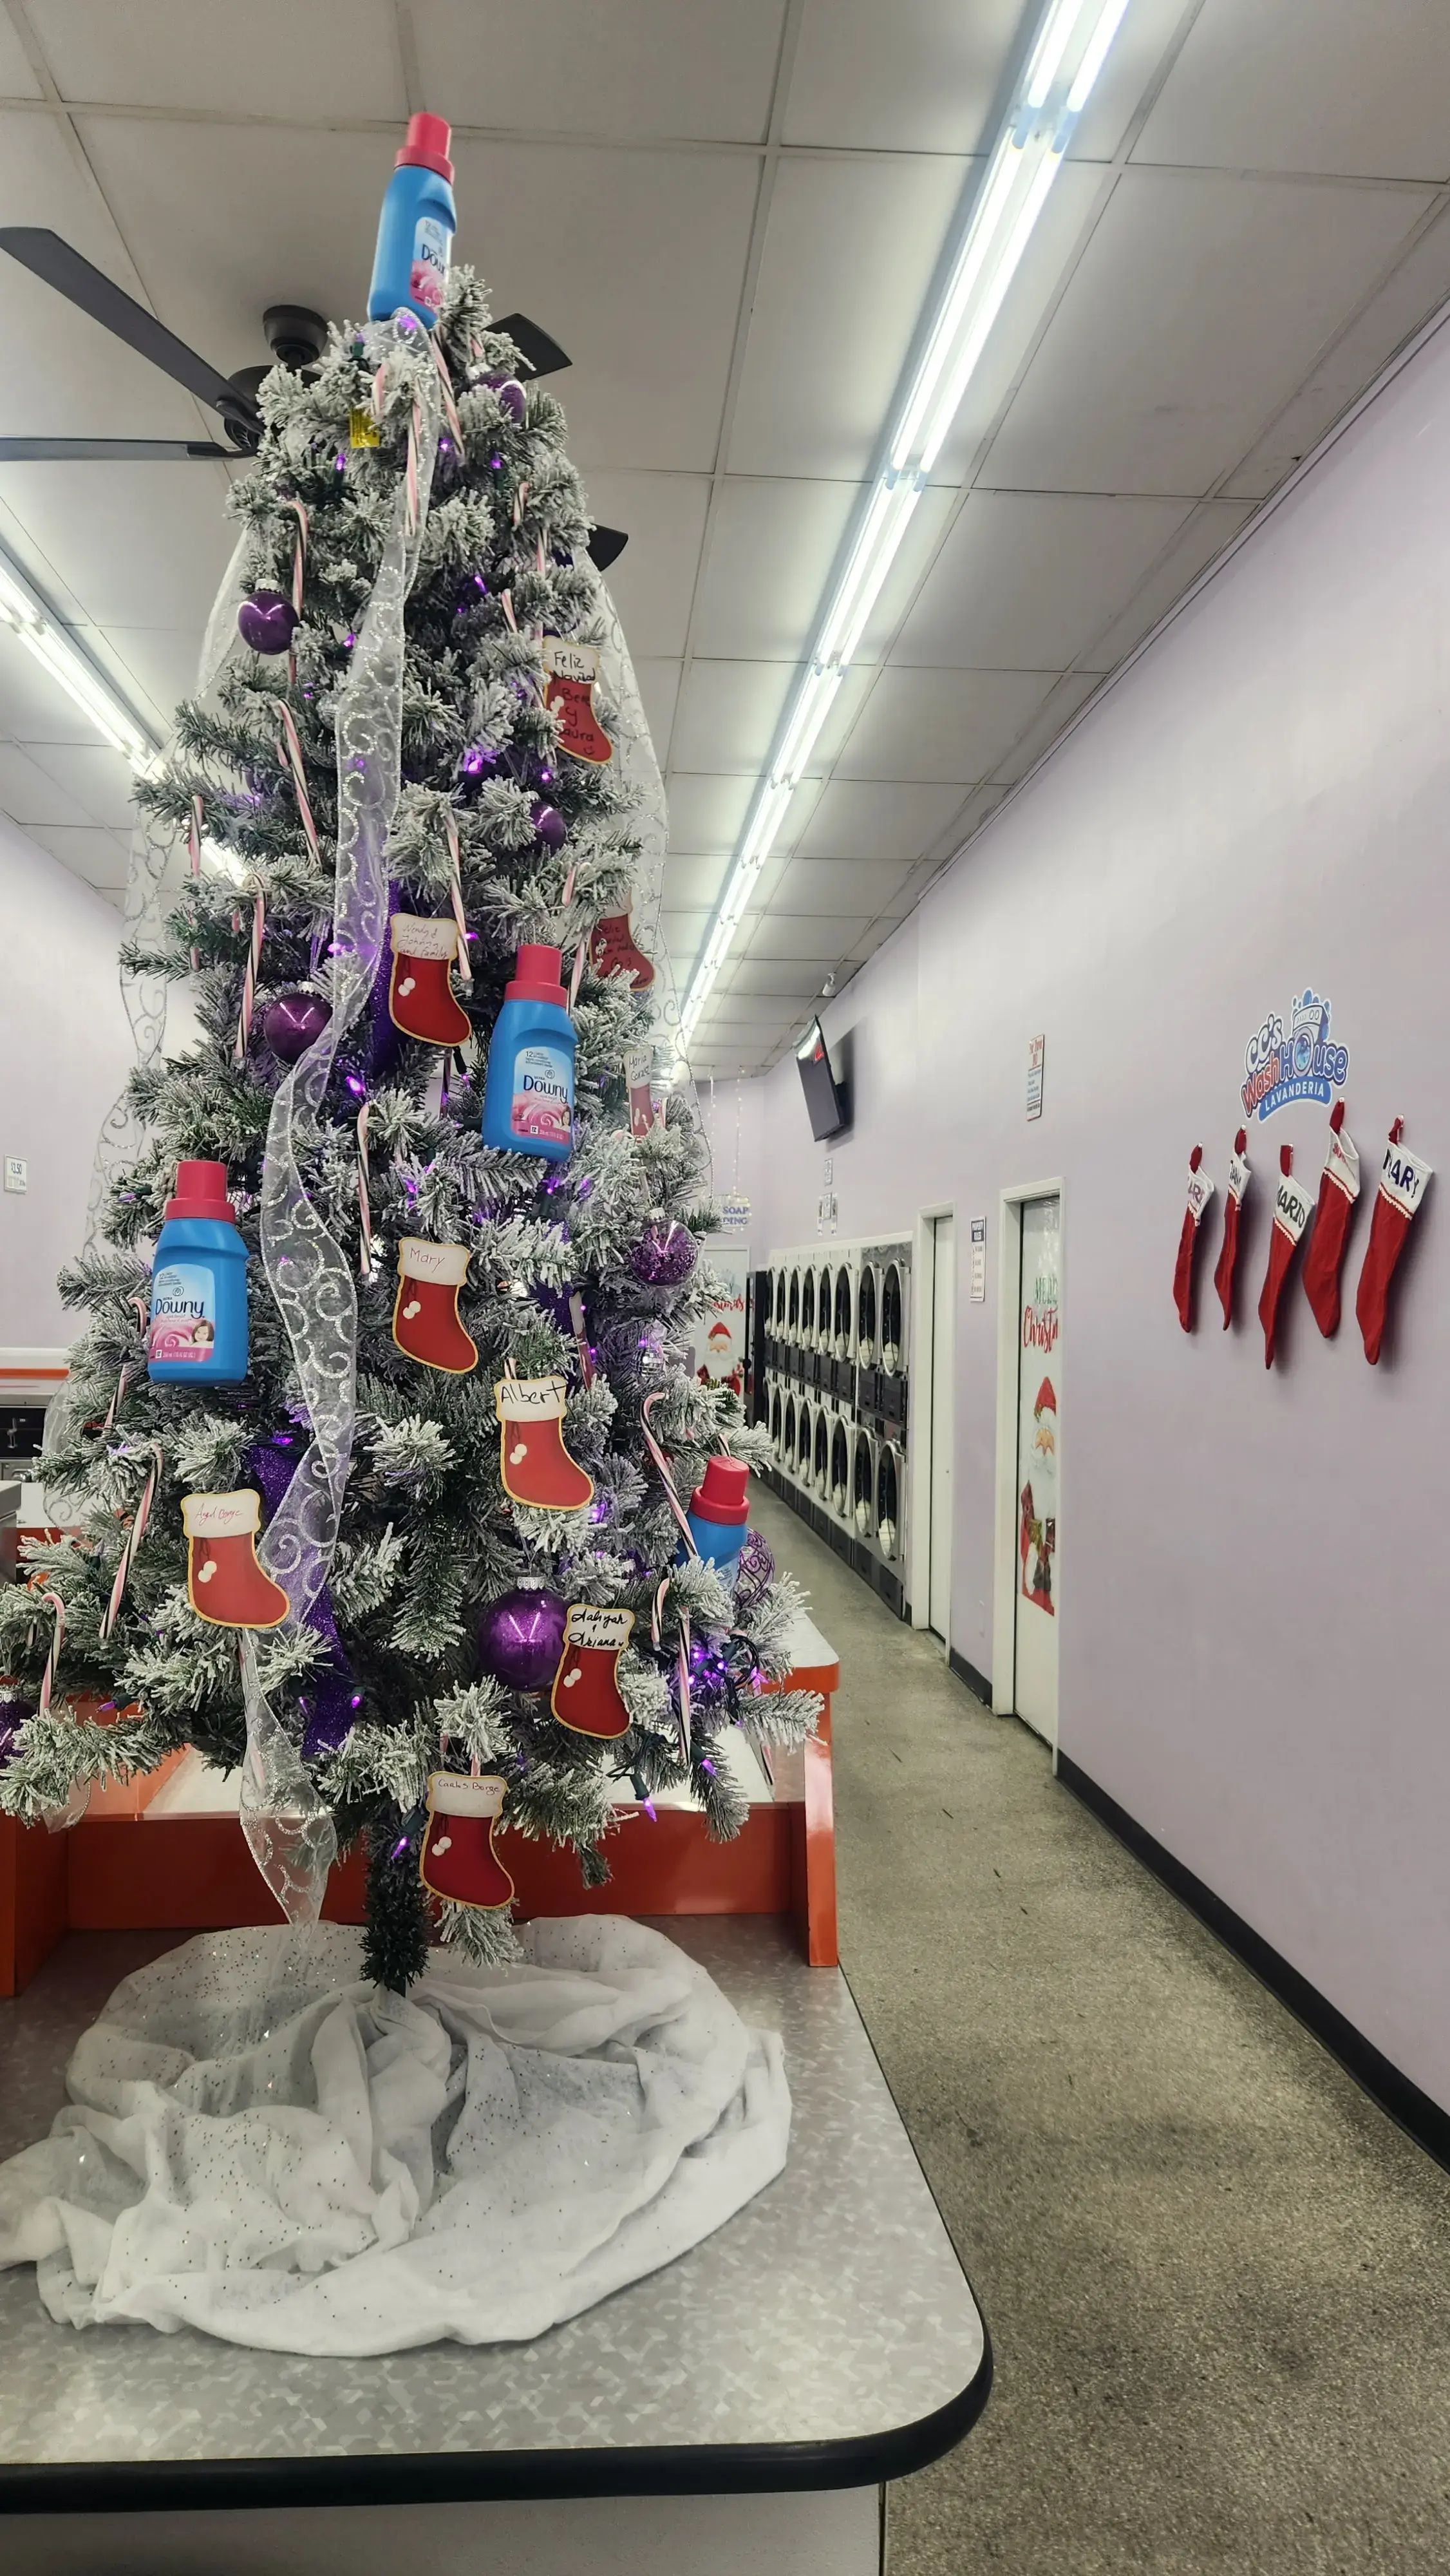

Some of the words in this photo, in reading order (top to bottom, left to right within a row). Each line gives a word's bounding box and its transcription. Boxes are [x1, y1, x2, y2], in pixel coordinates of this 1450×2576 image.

[554, 650, 585, 669] Feliz
[628, 1052, 648, 1070] Maria
[523, 1074, 569, 1105] Downy
[1265, 1081, 1324, 1112] LAVANDERIA
[1382, 1148, 1420, 1198] MARY
[722, 1206, 749, 1215] SOAP
[410, 1247, 446, 1273] Mary
[156, 1298, 205, 1320] Downy
[501, 1380, 567, 1405] Albert
[572, 1608, 628, 1629] Aaliyah
[568, 1631, 617, 1649] Ariana
[471, 1781, 501, 1796] Borge
